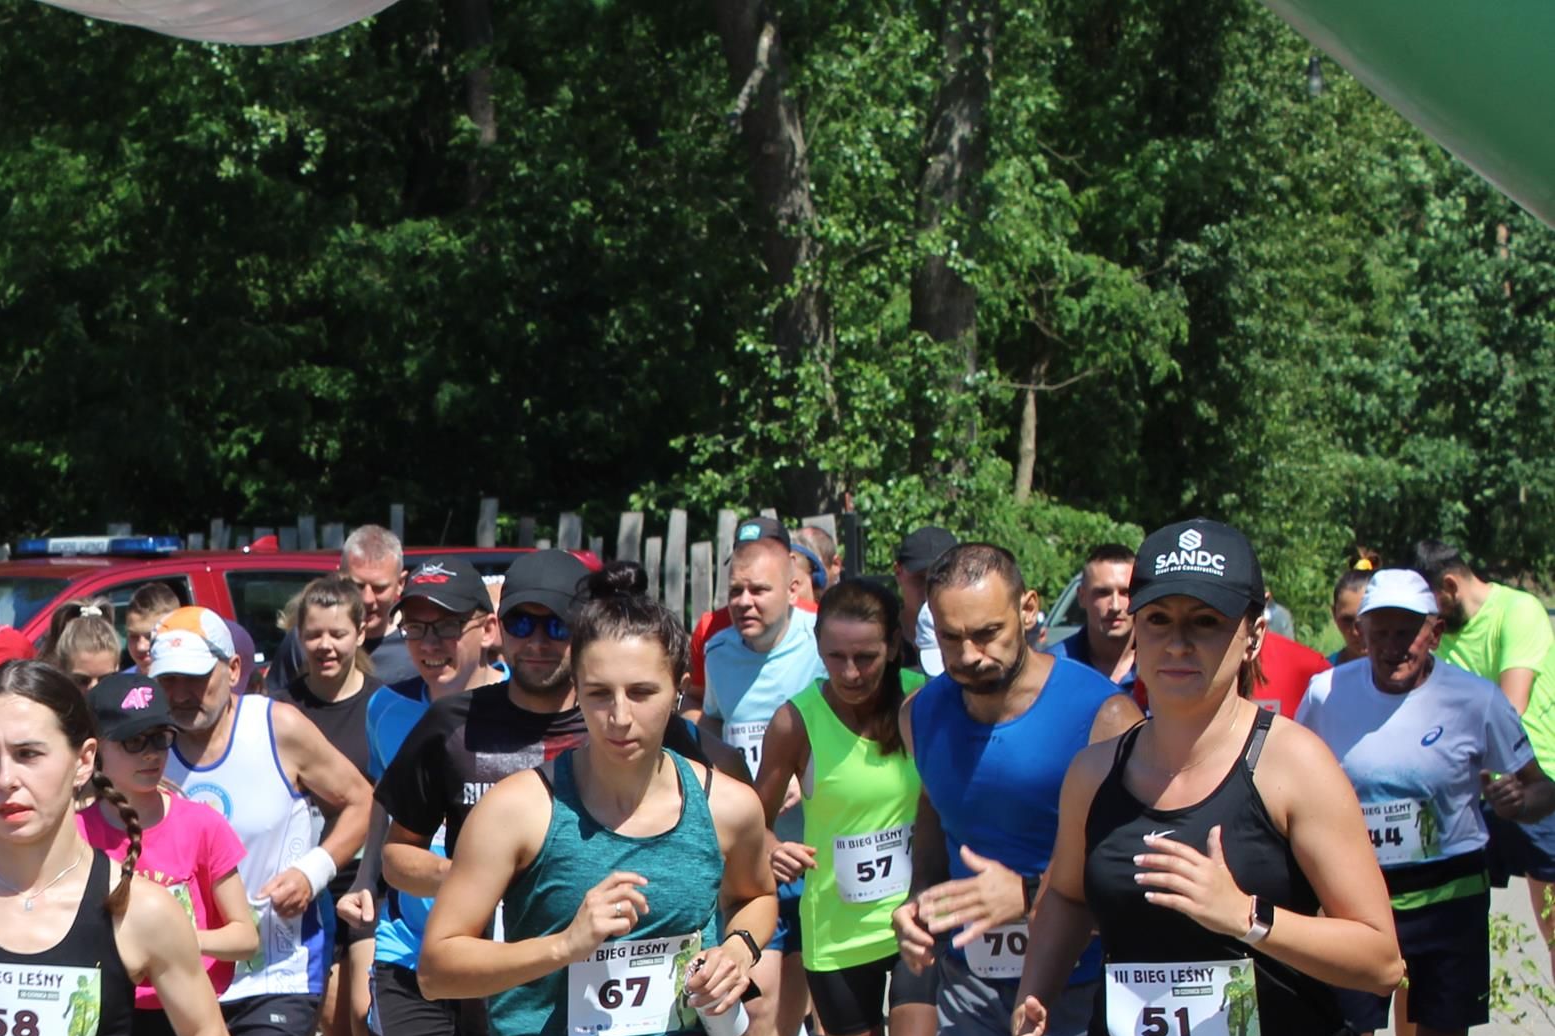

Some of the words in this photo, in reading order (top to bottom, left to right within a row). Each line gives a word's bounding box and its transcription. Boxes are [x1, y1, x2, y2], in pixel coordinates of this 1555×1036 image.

[1155, 550, 1225, 570] SANDC
[837, 840, 845, 849] III
[848, 837, 872, 849] BIEG
[874, 828, 903, 844] LEŚNY
[1368, 826, 1403, 848] 44
[857, 855, 893, 883] 57
[596, 948, 626, 962] BIEG
[630, 942, 670, 957] LEŚNY
[983, 931, 1028, 957] 70
[19, 970, 64, 988] LEŚNY
[1114, 971, 1128, 983] III
[1134, 970, 1165, 983] BIEG
[1171, 966, 1214, 983] LEŚNY
[598, 976, 651, 1009] 67
